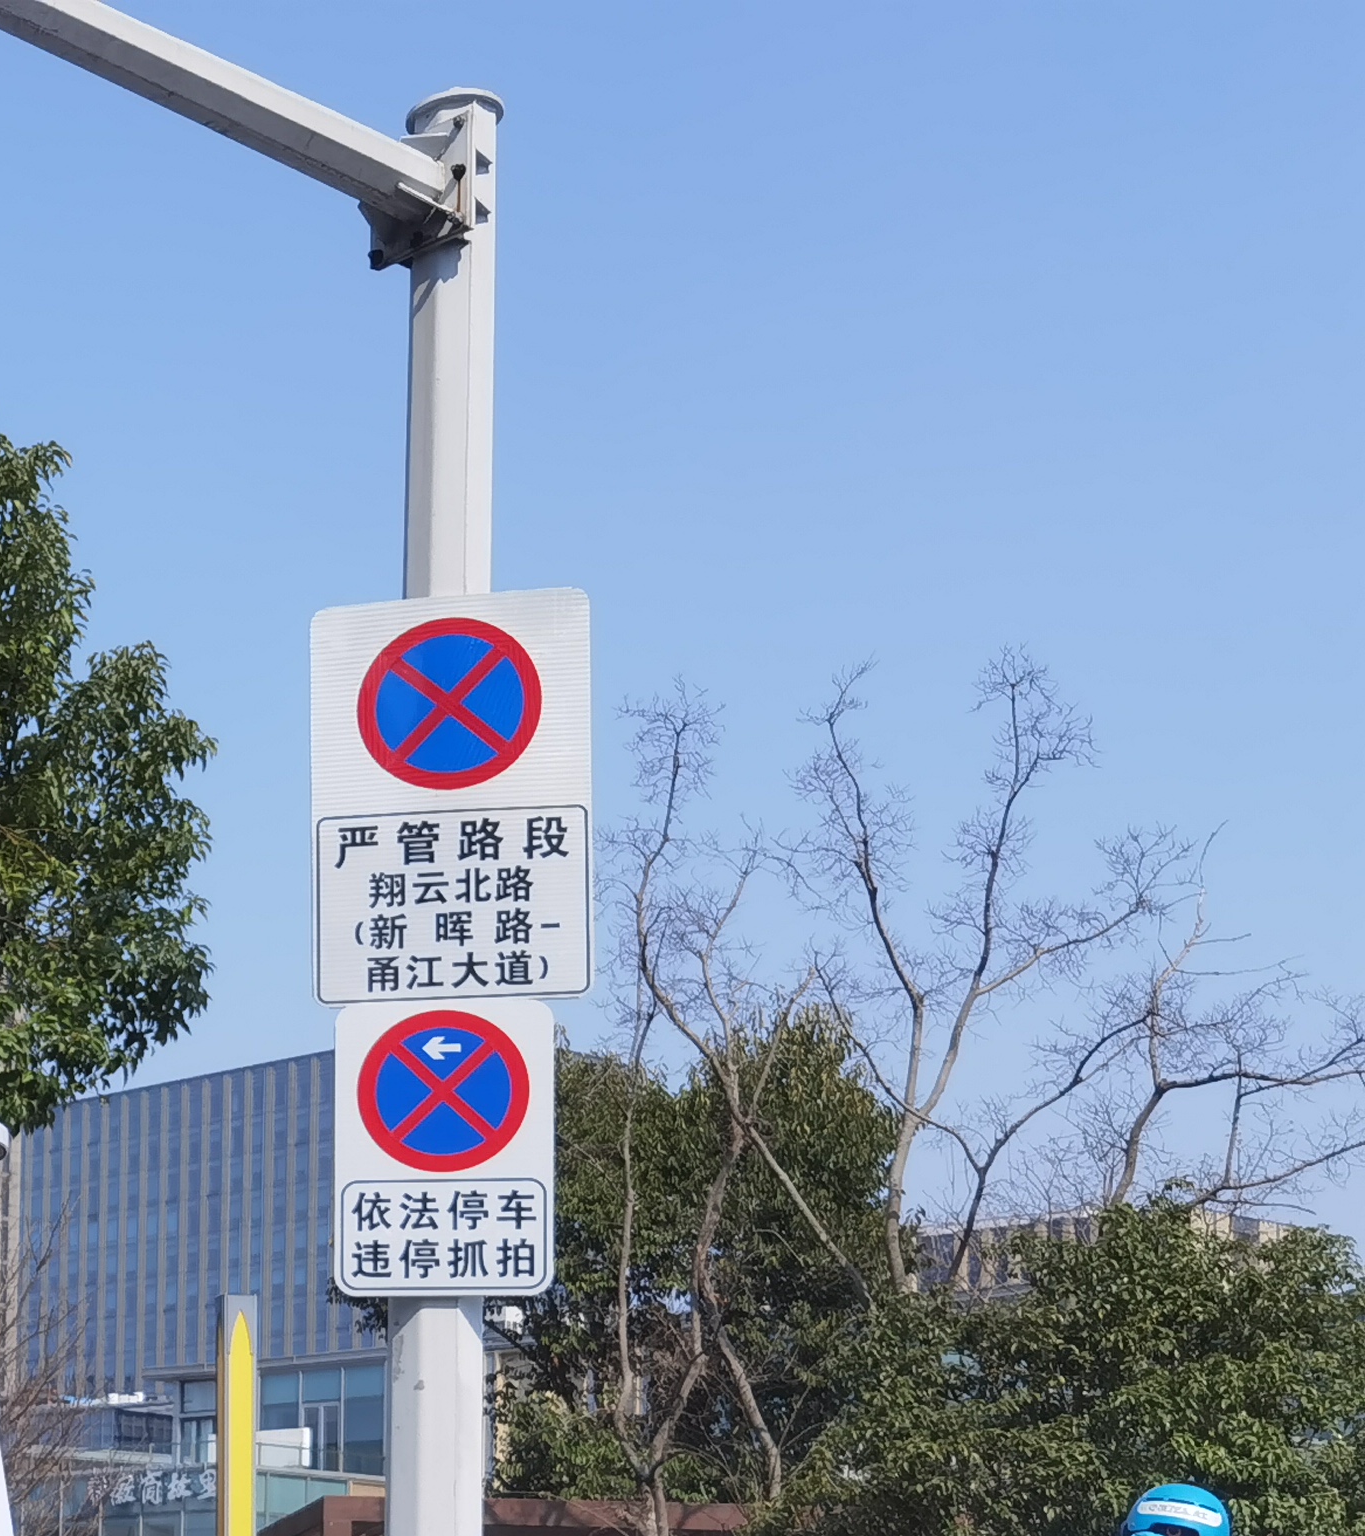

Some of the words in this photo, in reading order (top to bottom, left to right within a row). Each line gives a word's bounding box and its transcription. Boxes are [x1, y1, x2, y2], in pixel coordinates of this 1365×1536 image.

[334, 815, 570, 869] 严管路段
[368, 865, 534, 908] 翔云北路
[367, 950, 549, 992] 甬江大道)
[351, 1189, 537, 1231] 依法停车
[351, 1238, 536, 1279] 违停抓拍
